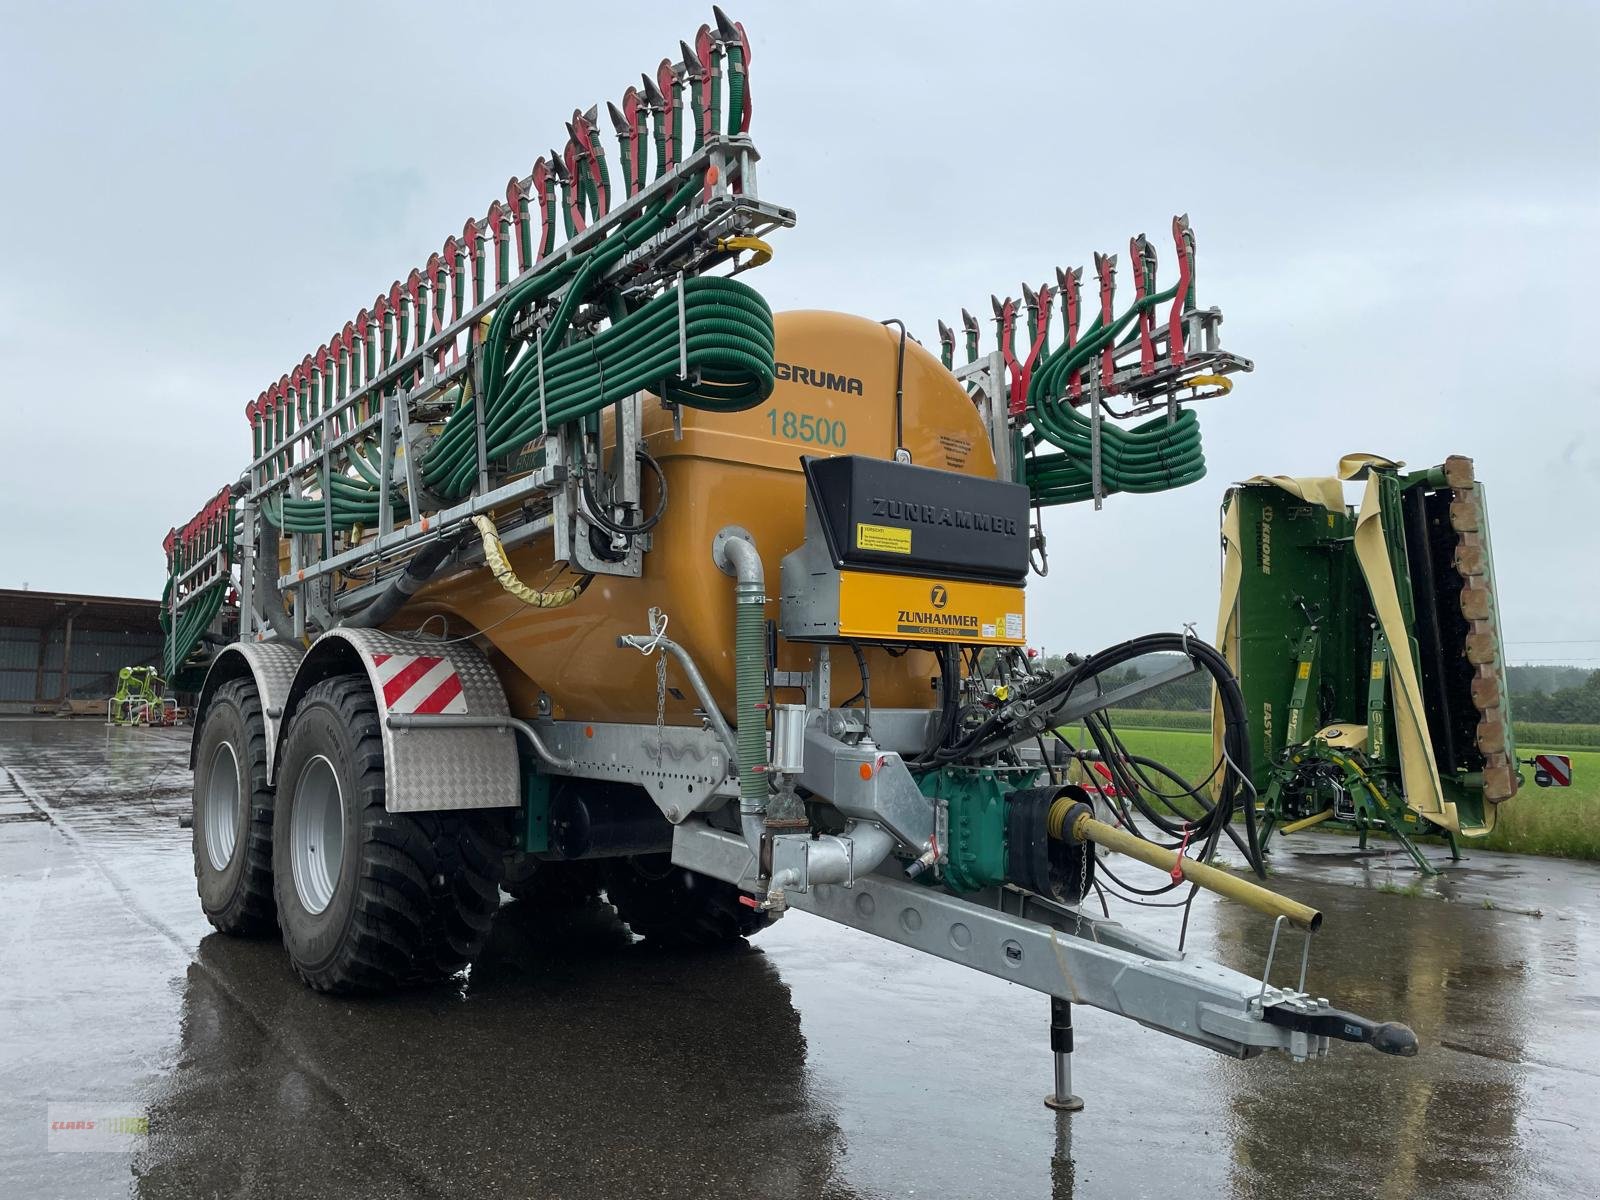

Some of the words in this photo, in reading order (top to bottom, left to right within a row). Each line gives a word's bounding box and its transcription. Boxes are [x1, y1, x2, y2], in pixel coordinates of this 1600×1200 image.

[774, 362, 863, 396] GRUMA
[767, 408, 847, 448] 18500
[872, 498, 1016, 536] ZUNHAMMER
[1262, 522, 1271, 576] KRONE
[897, 610, 978, 627] ZUNHAMMER
